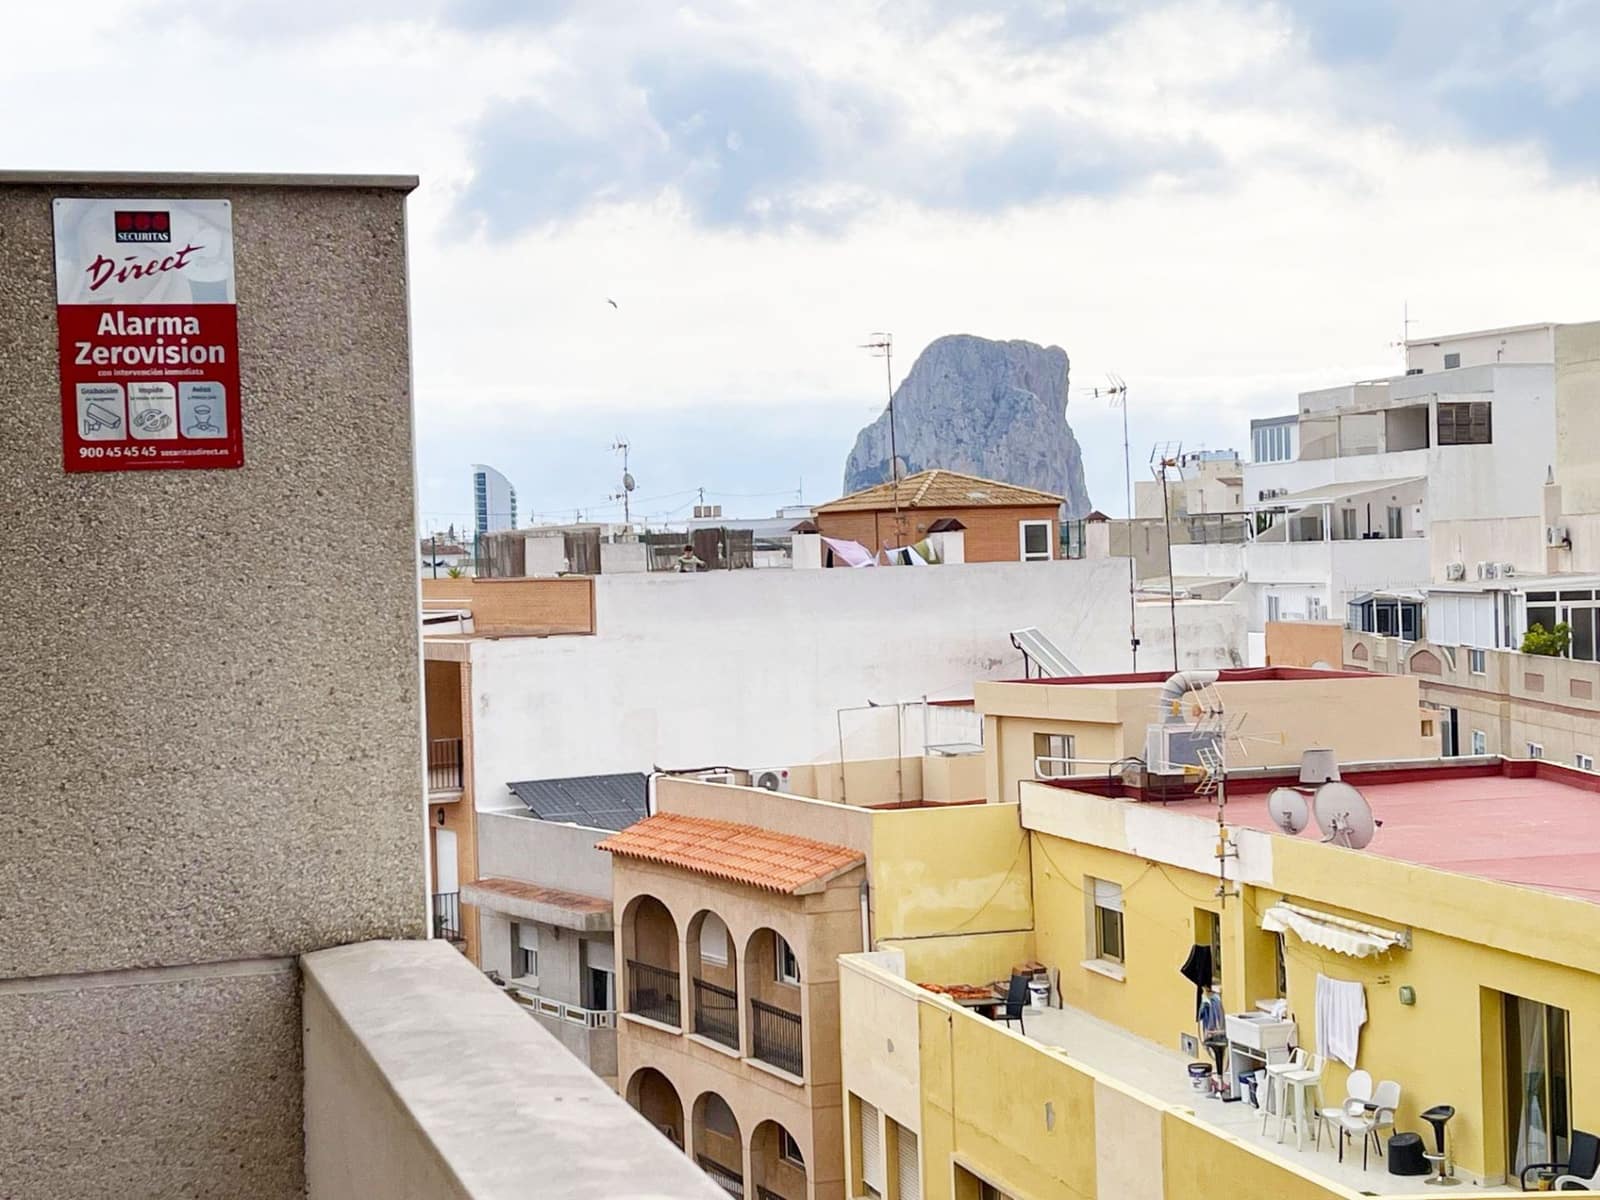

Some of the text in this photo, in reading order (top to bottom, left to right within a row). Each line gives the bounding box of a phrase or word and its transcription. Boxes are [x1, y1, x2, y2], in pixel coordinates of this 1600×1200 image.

[117, 232, 169, 242] SECURITAS
[86, 244, 205, 291] Direct
[97, 311, 200, 336] Alarma
[74, 338, 225, 366] Zerovision
[79, 447, 104, 458] 900
[106, 447, 121, 458] 45
[123, 446, 139, 457] 45
[141, 446, 157, 457] 45
